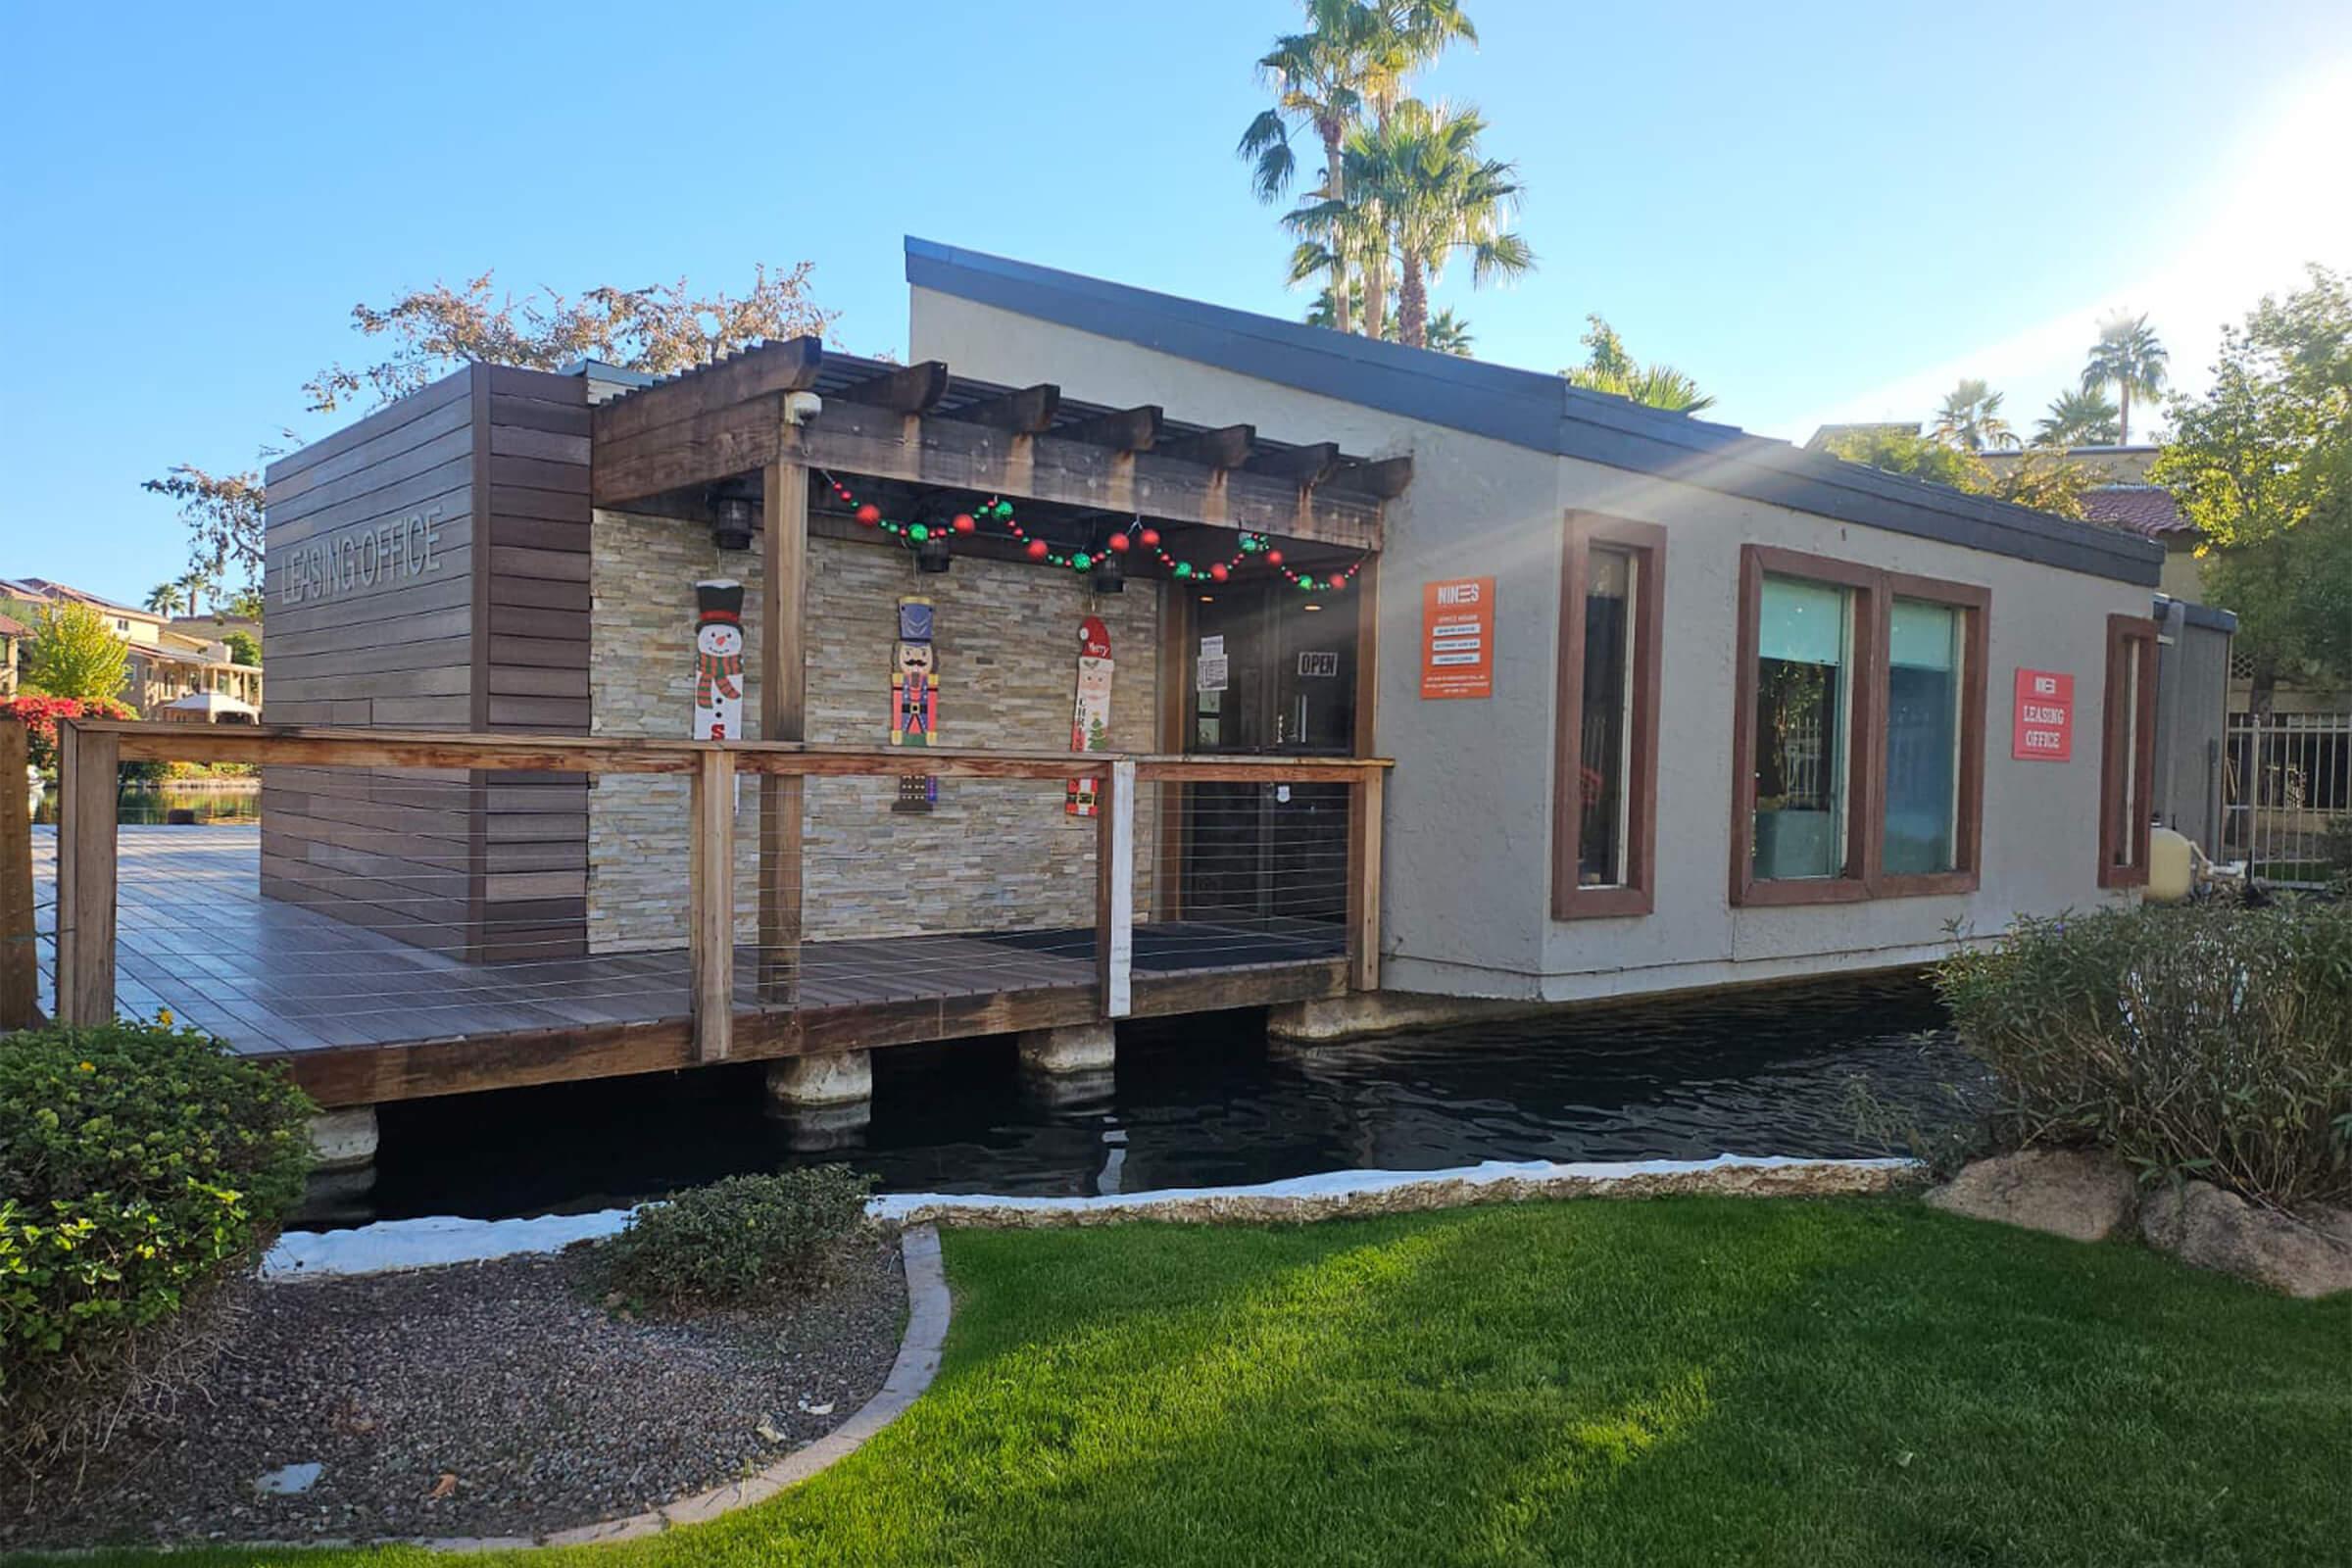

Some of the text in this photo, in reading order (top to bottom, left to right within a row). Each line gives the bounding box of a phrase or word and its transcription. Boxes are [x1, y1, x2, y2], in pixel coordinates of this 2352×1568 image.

[282, 507, 443, 605] LEASING OFFICE
[1438, 583, 1480, 605] NINES
[1301, 654, 1334, 674] OPEN
[2023, 705, 2064, 725] LEASING
[2026, 730, 2060, 749] OFFICE
